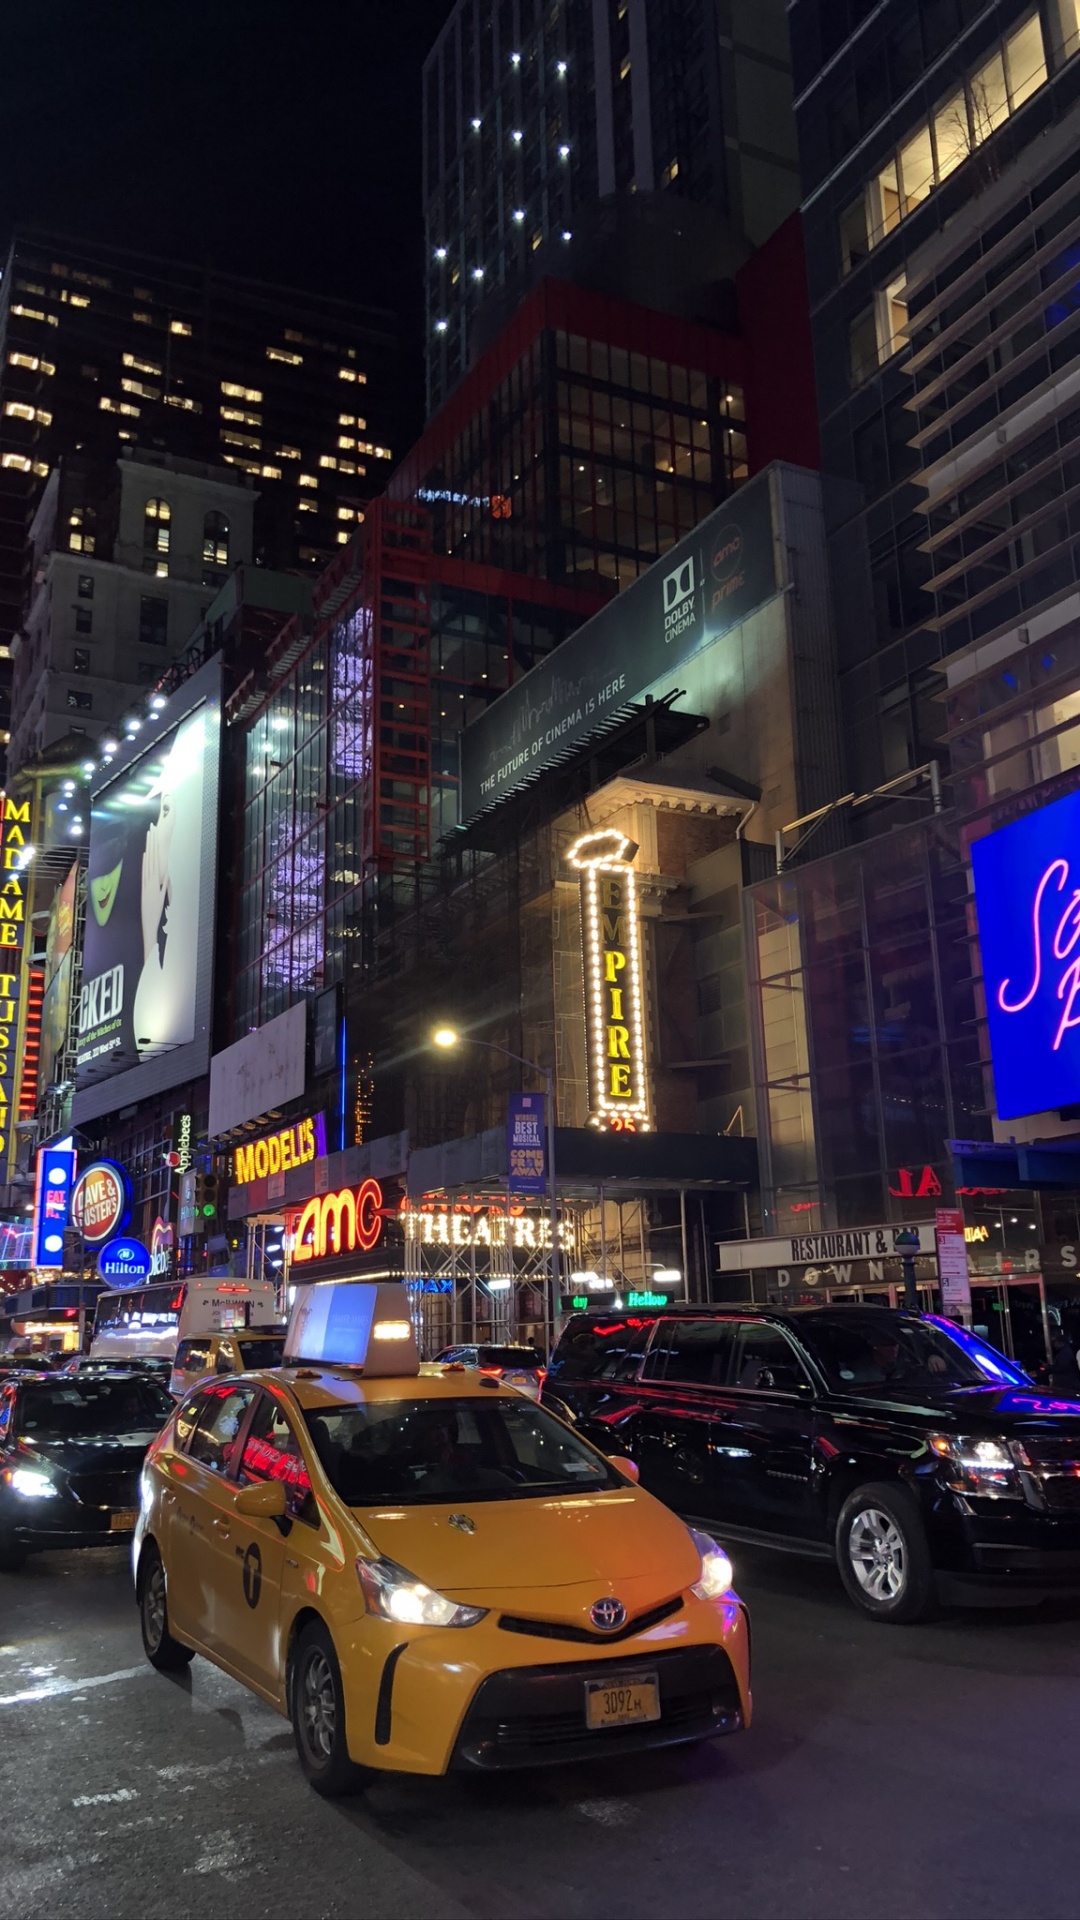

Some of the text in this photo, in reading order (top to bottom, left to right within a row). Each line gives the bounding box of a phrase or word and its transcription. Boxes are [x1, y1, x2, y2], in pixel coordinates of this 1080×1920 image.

[664, 596, 695, 630] DOLBY
[664, 612, 697, 644] CINEMA
[480, 673, 626, 796] THE FUTURE OF CINEMA IS HERE
[0, 799, 31, 946] MADAME
[601, 878, 632, 1098] EMPIRE
[513, 1134, 541, 1143] MUSICAL
[515, 1121, 538, 1134] BEST
[174, 1114, 192, 1175] Applebee's
[235, 1117, 314, 1185] MODELL'S
[510, 1149, 543, 1159] COME
[511, 1167, 544, 1177] AWAY
[78, 1179, 116, 1210] DAVE &
[400, 1212, 575, 1250] THEATRES
[791, 1231, 871, 1262] RESTAURANT
[875, 1230, 888, 1254] &
[105, 1262, 145, 1274] Hilton
